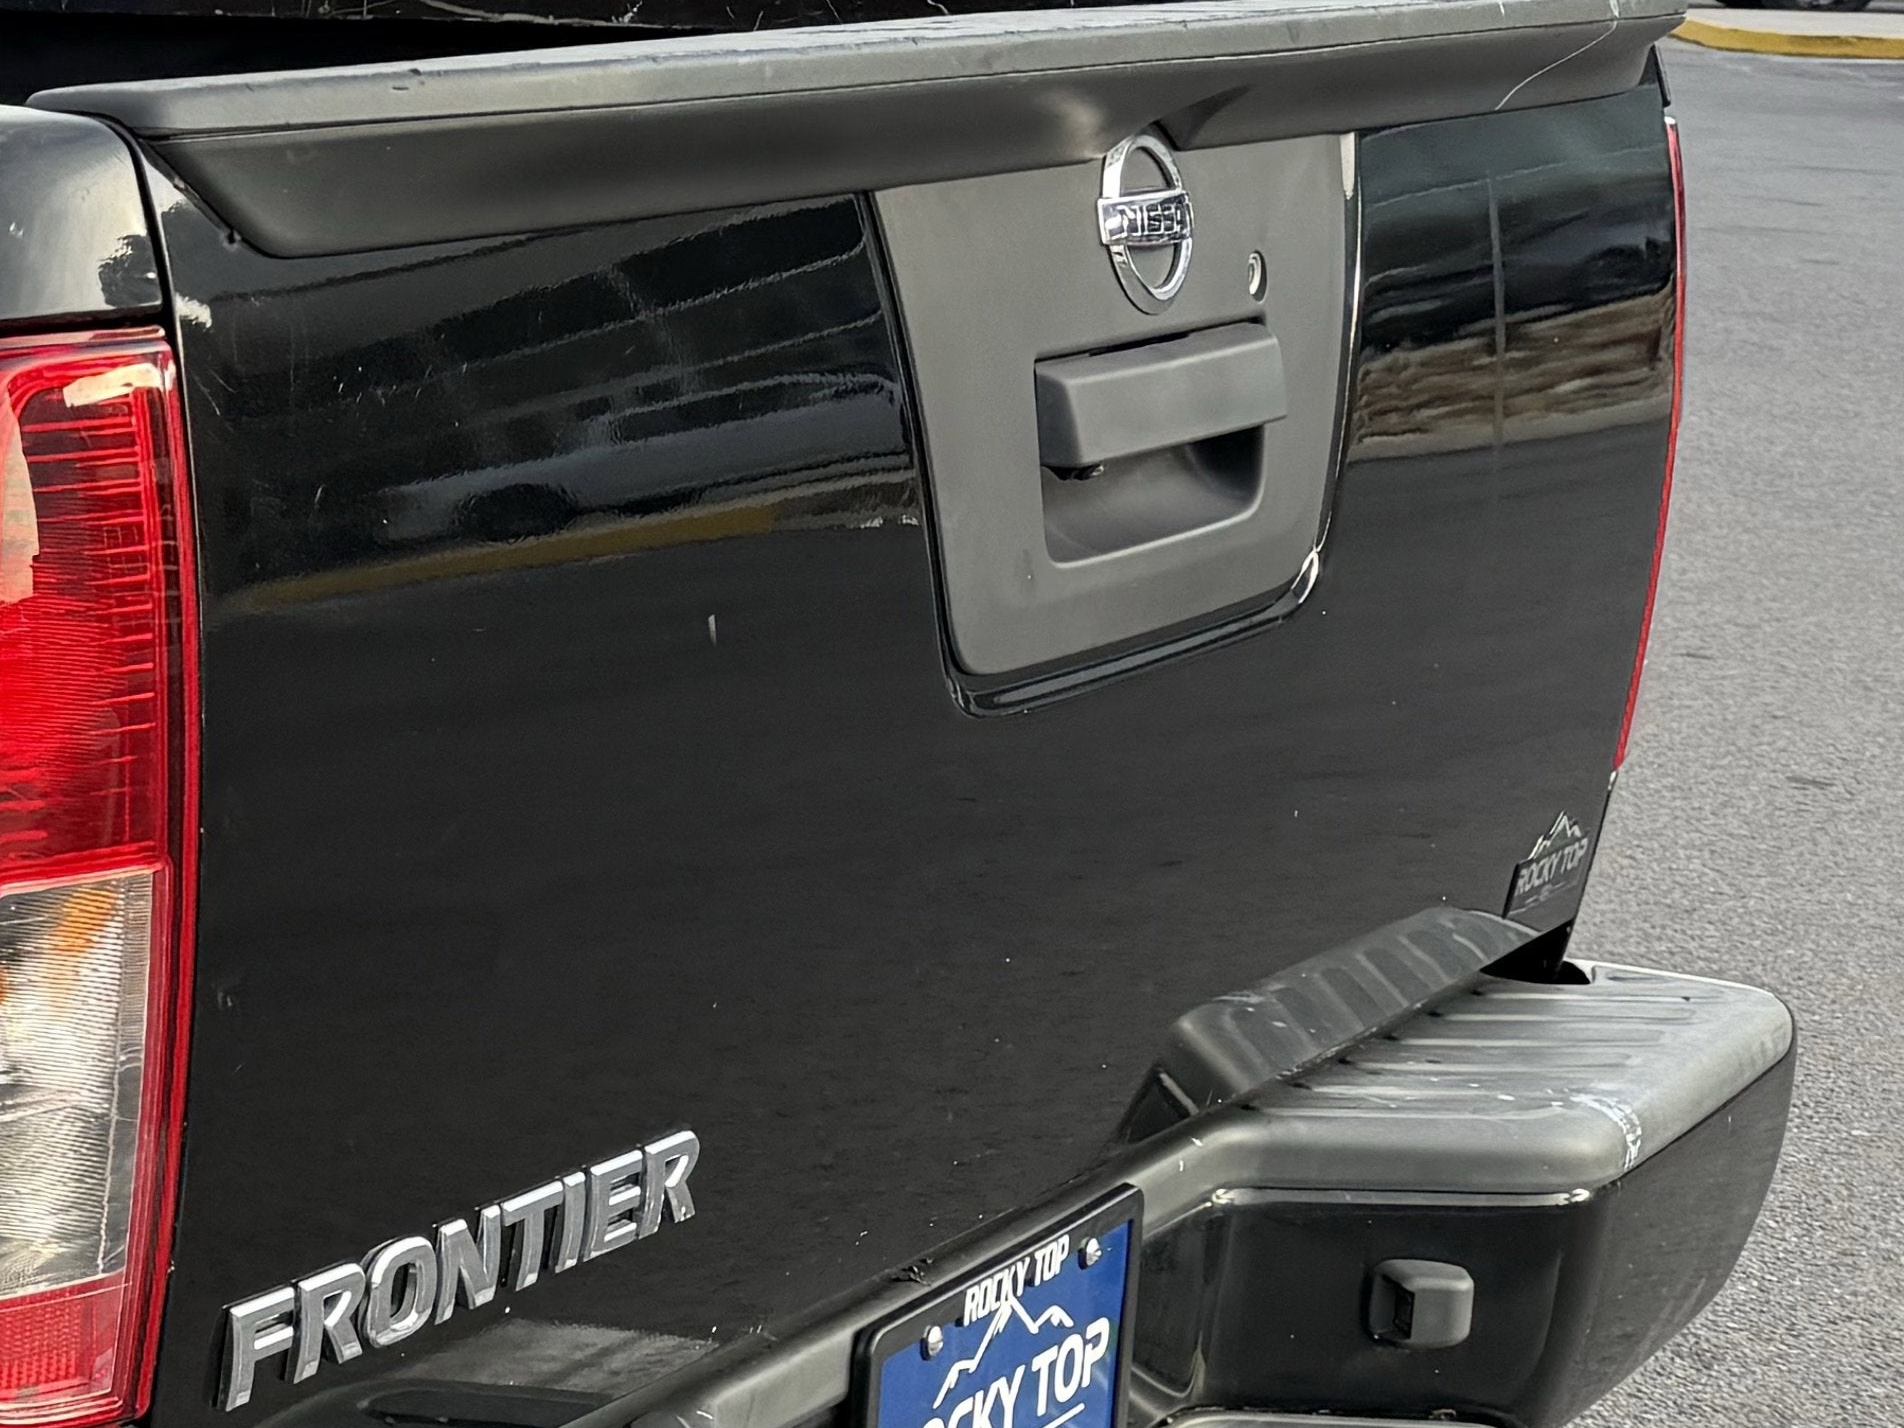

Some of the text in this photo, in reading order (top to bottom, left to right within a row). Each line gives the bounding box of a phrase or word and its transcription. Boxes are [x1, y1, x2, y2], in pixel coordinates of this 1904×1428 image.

[1560, 837, 1589, 874] TOP
[223, 1129, 701, 1412] FRONTIER
[963, 1234, 1071, 1327] ROCKY TOP
[1031, 1317, 1111, 1418] TOP
